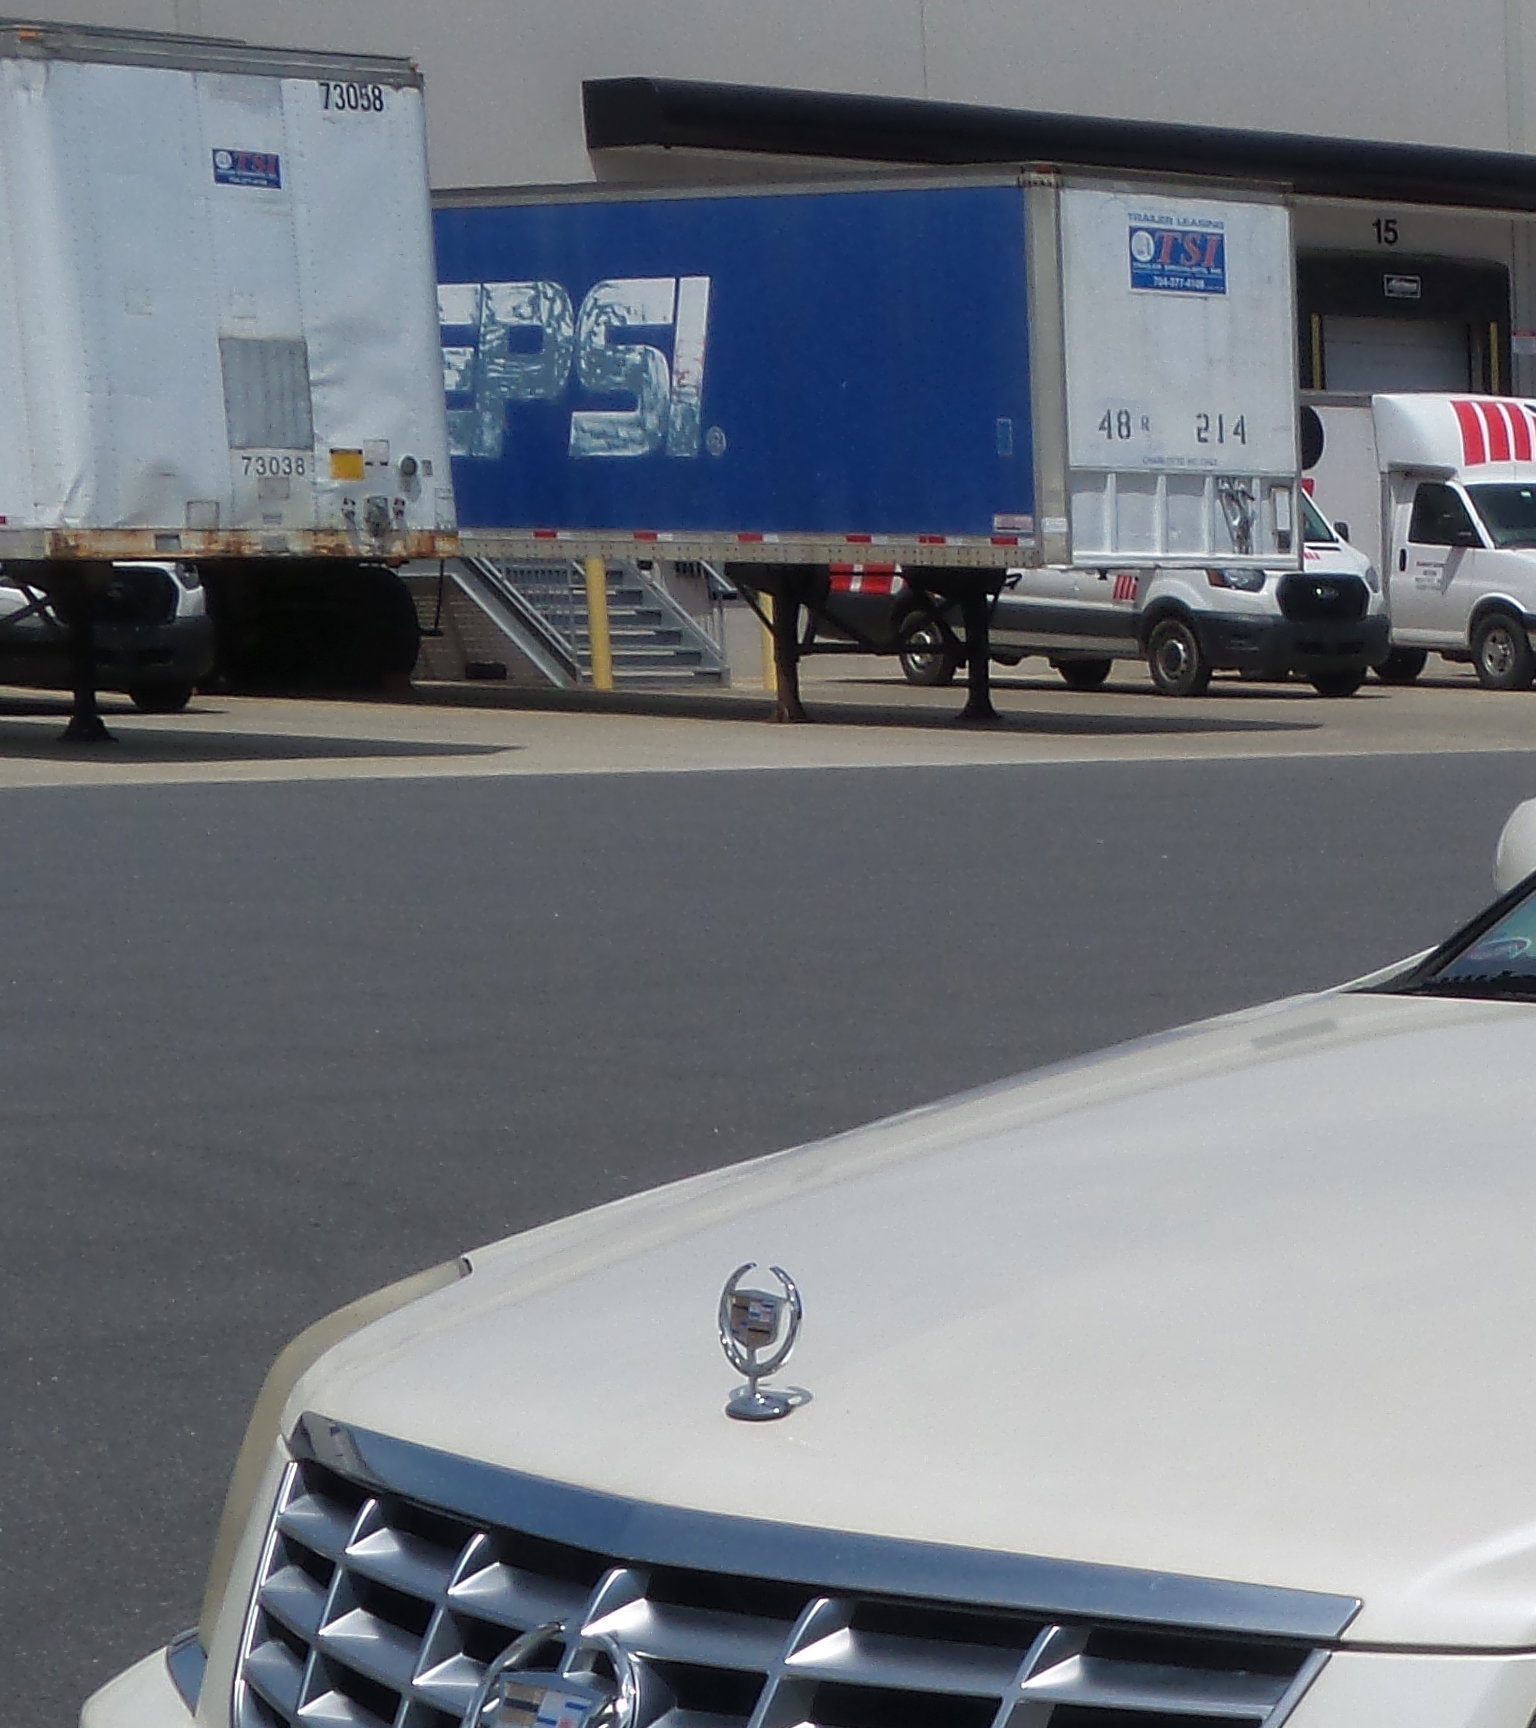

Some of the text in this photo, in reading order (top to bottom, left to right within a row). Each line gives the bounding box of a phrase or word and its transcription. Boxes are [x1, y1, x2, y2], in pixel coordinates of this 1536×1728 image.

[319, 82, 385, 112] 73058
[1372, 217, 1399, 245] 15
[1155, 230, 1221, 268] TSI
[1099, 408, 1132, 441] 48
[1196, 412, 1247, 445] 214
[241, 455, 306, 476] 73038
